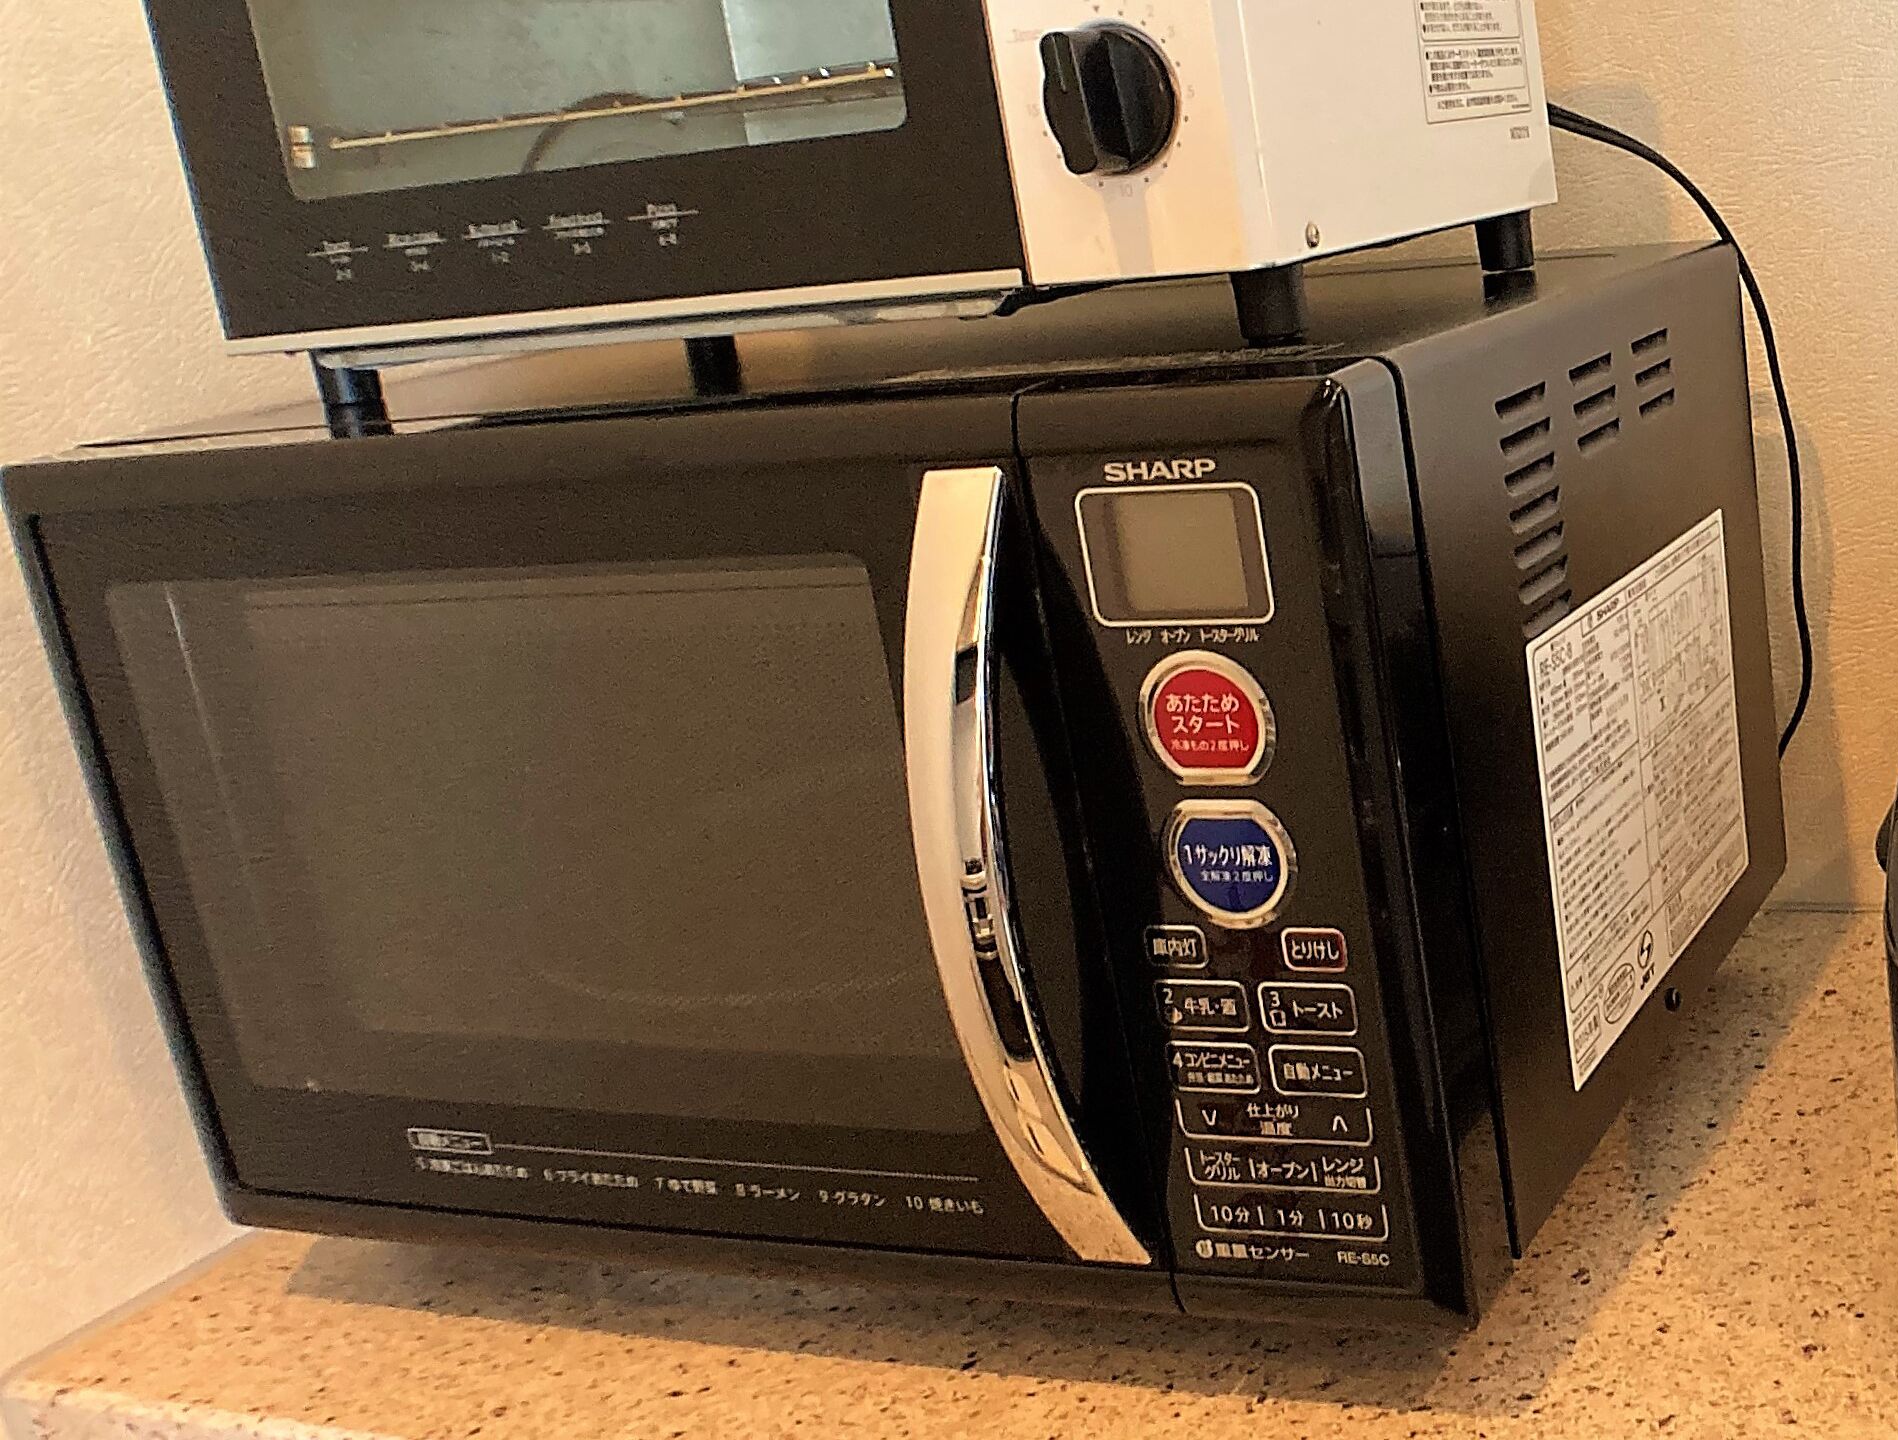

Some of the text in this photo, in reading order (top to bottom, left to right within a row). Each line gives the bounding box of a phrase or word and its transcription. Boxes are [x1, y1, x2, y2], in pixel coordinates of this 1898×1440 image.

[1103, 458, 1217, 482] SHARP
[1166, 693, 1240, 713] あたため
[1171, 713, 1241, 734] スタート
[1291, 940, 1340, 961] とりけし
[1269, 990, 1280, 1007] 3
[1291, 1000, 1344, 1020] トースト
[1322, 1156, 1364, 1174] レンジ
[1210, 1205, 1250, 1224] 10分
[1277, 1208, 1304, 1227] 1分
[1331, 1211, 1373, 1230] 10秒
